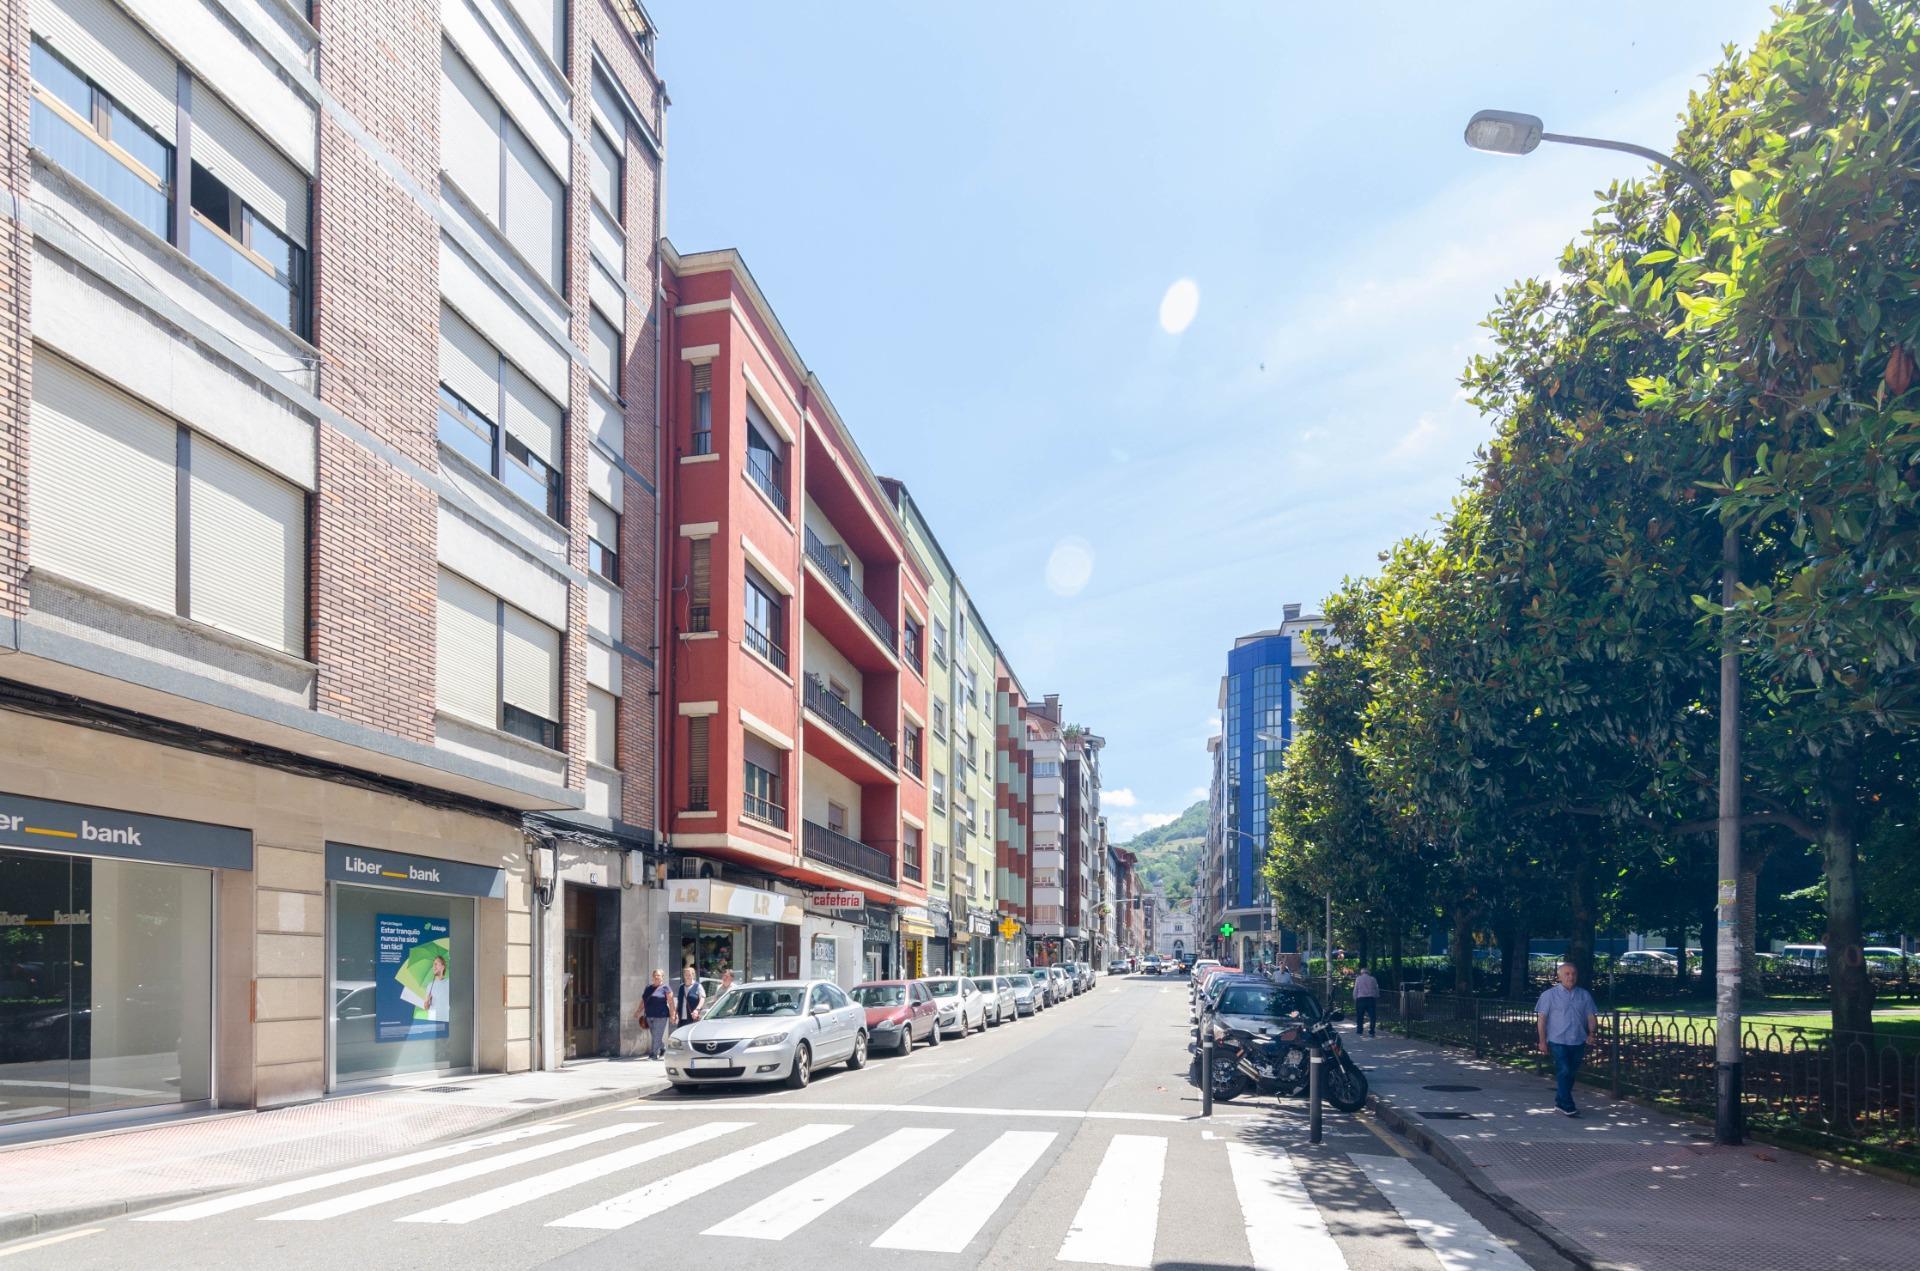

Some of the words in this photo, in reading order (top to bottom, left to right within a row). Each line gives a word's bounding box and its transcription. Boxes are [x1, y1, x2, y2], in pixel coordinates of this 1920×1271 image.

[81, 820, 142, 846] bank
[345, 856, 382, 875] Liber
[409, 865, 440, 882] bank
[674, 888, 699, 903] LR
[753, 893, 770, 915] LR
[54, 909, 91, 925] bank
[380, 926, 396, 934] Estar
[396, 928, 421, 936] tranquilo
